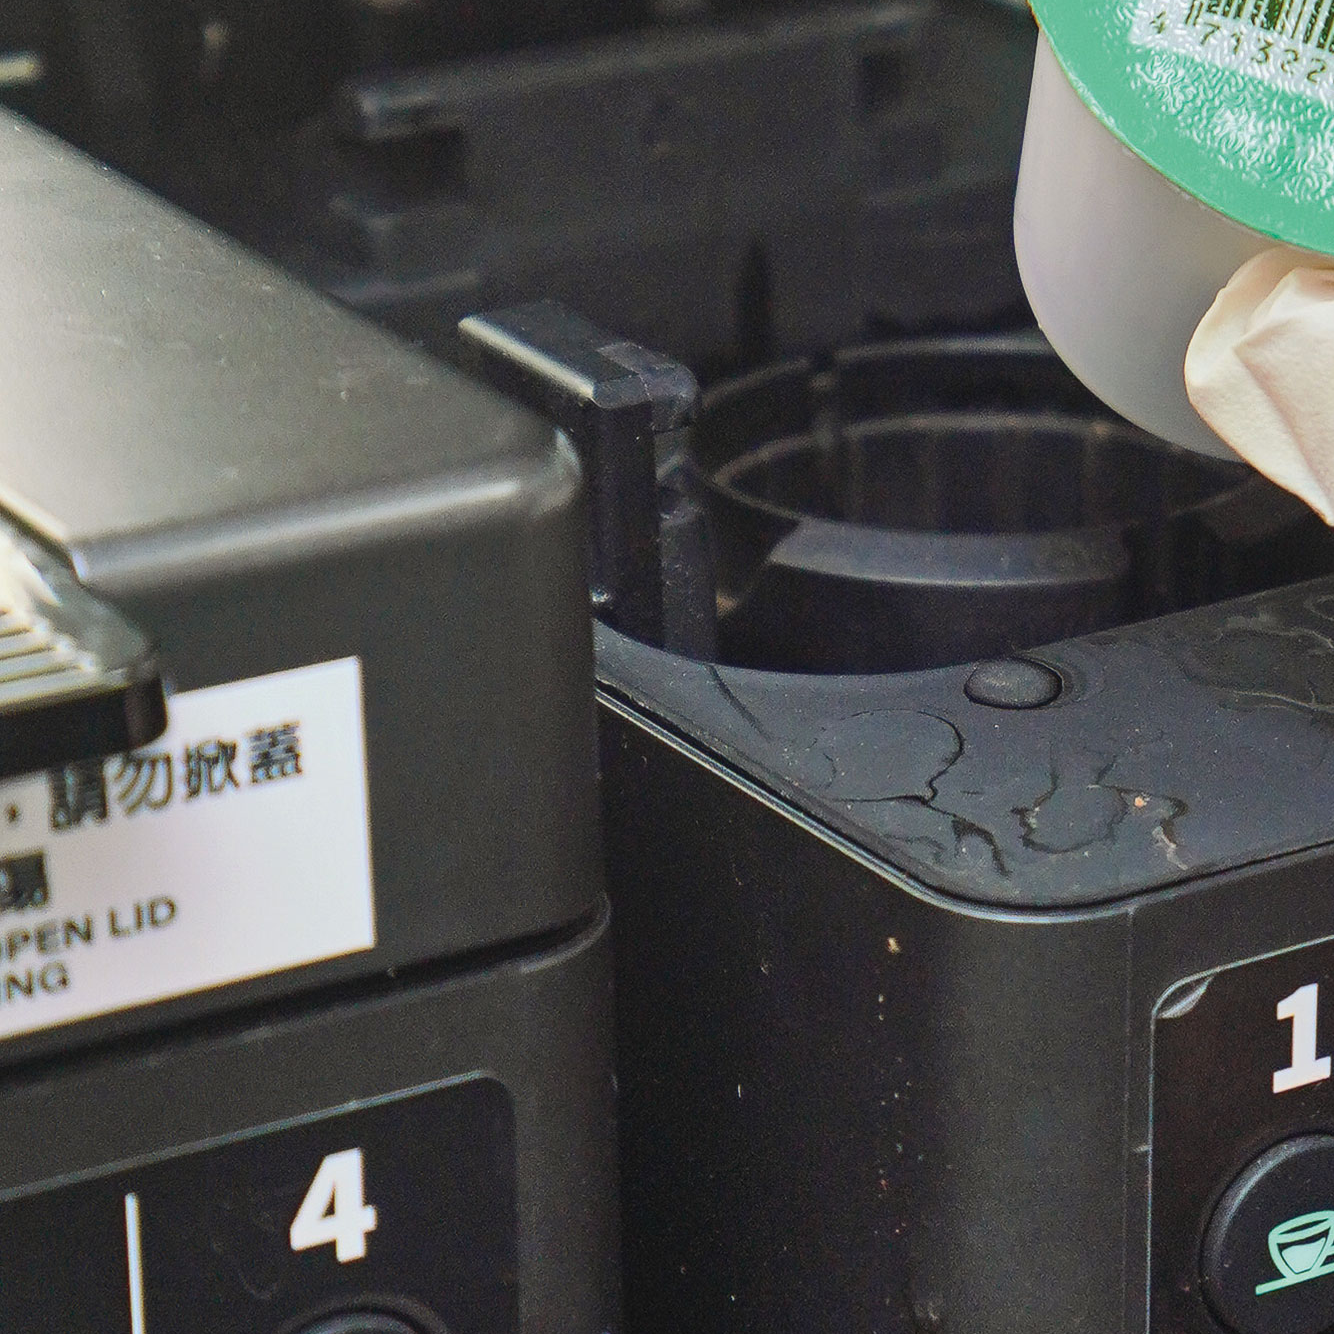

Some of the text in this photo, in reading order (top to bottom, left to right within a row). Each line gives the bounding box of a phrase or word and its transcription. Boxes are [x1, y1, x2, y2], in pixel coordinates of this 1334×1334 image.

[106, 895, 178, 940] LID
[1272, 983, 1332, 1094] 1
[289, 1148, 377, 1263] 4
